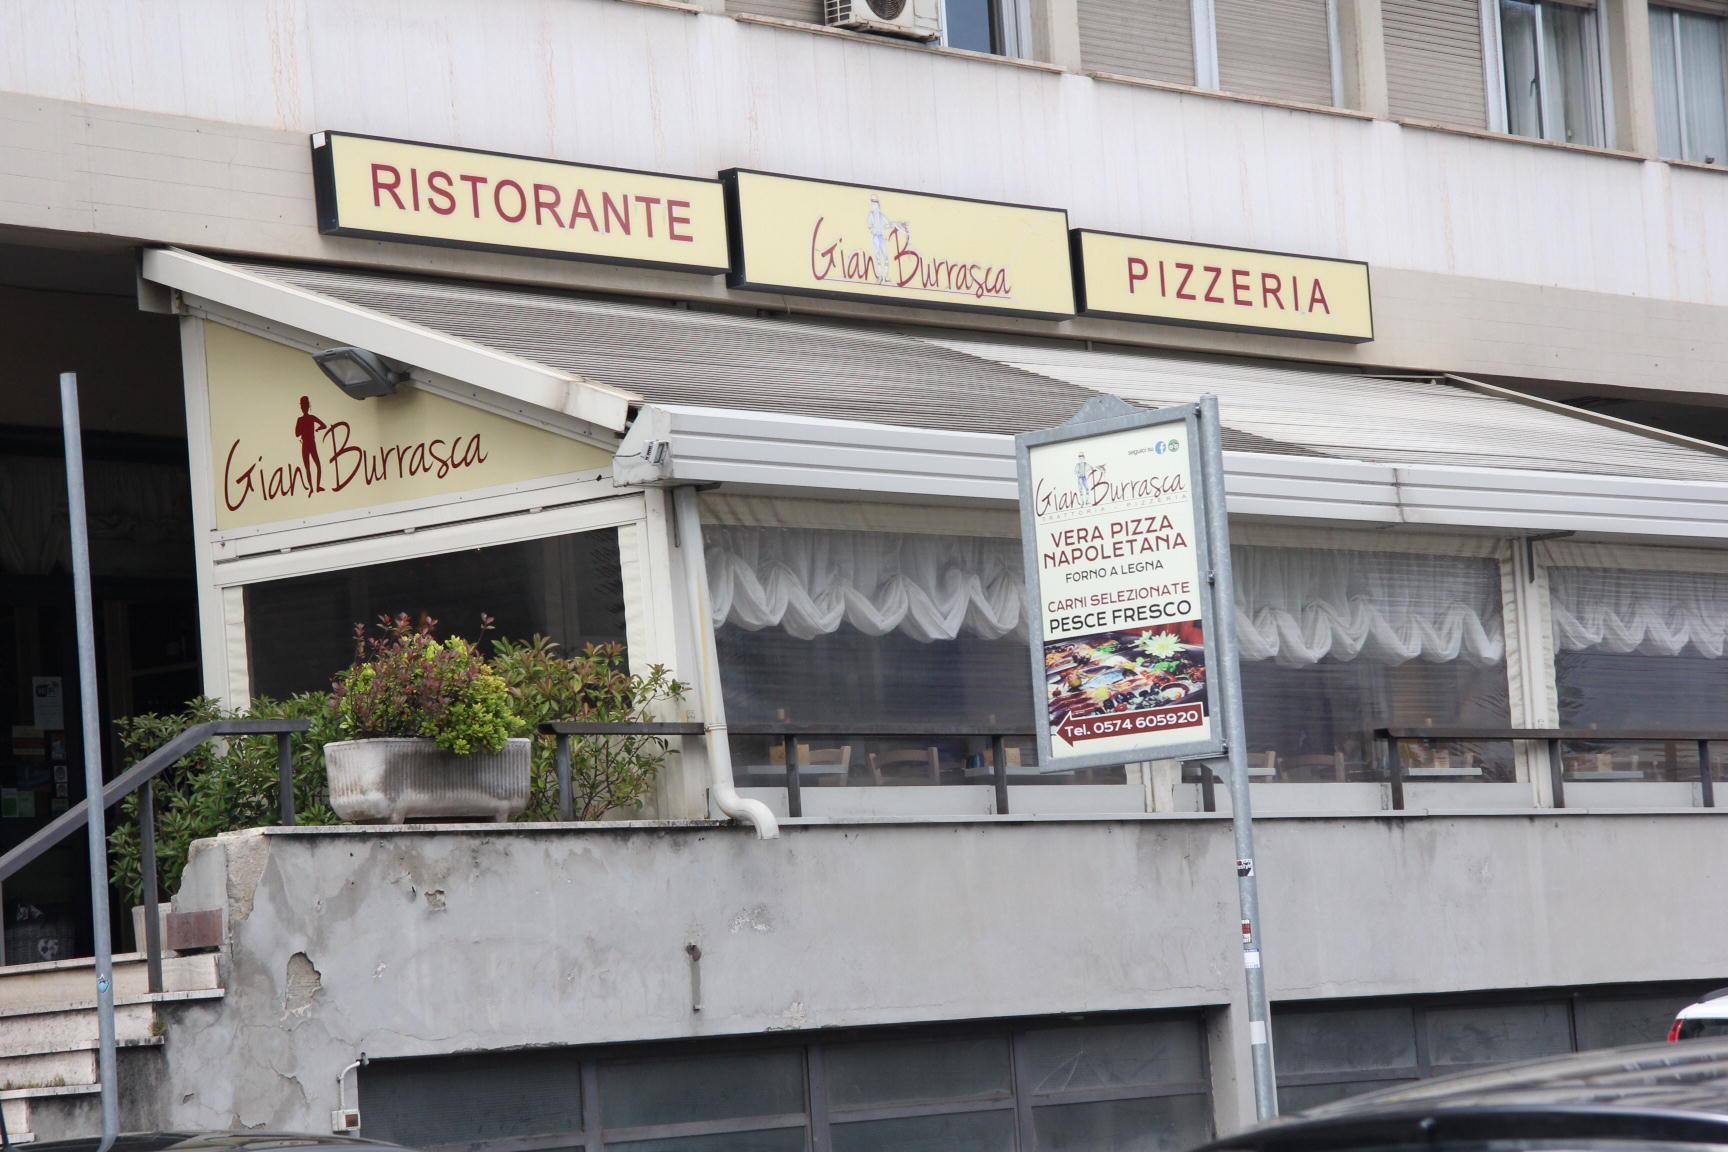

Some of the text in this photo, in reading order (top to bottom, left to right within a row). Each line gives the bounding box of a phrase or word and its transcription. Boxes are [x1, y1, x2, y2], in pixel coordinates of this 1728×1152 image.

[371, 163, 694, 243] RISTORANTE
[811, 216, 1011, 299] Gian Burrasca
[1127, 257, 1330, 315] PIZZERIA
[224, 421, 489, 512] Gian Burrasca
[1035, 468, 1185, 517] Gian Burrasca
[1126, 493, 1187, 508] PIZZERIA
[1051, 515, 1174, 548] VERA PIZZA
[1043, 532, 1188, 569] NAPOLETANA
[1065, 559, 1164, 584] FORNO A LEGNA
[1047, 581, 1191, 613] CARNI SELEZIONATE
[1050, 600, 1192, 634] PESCE FRESCO
[1064, 710, 1199, 737] Tel. 0574 605920
